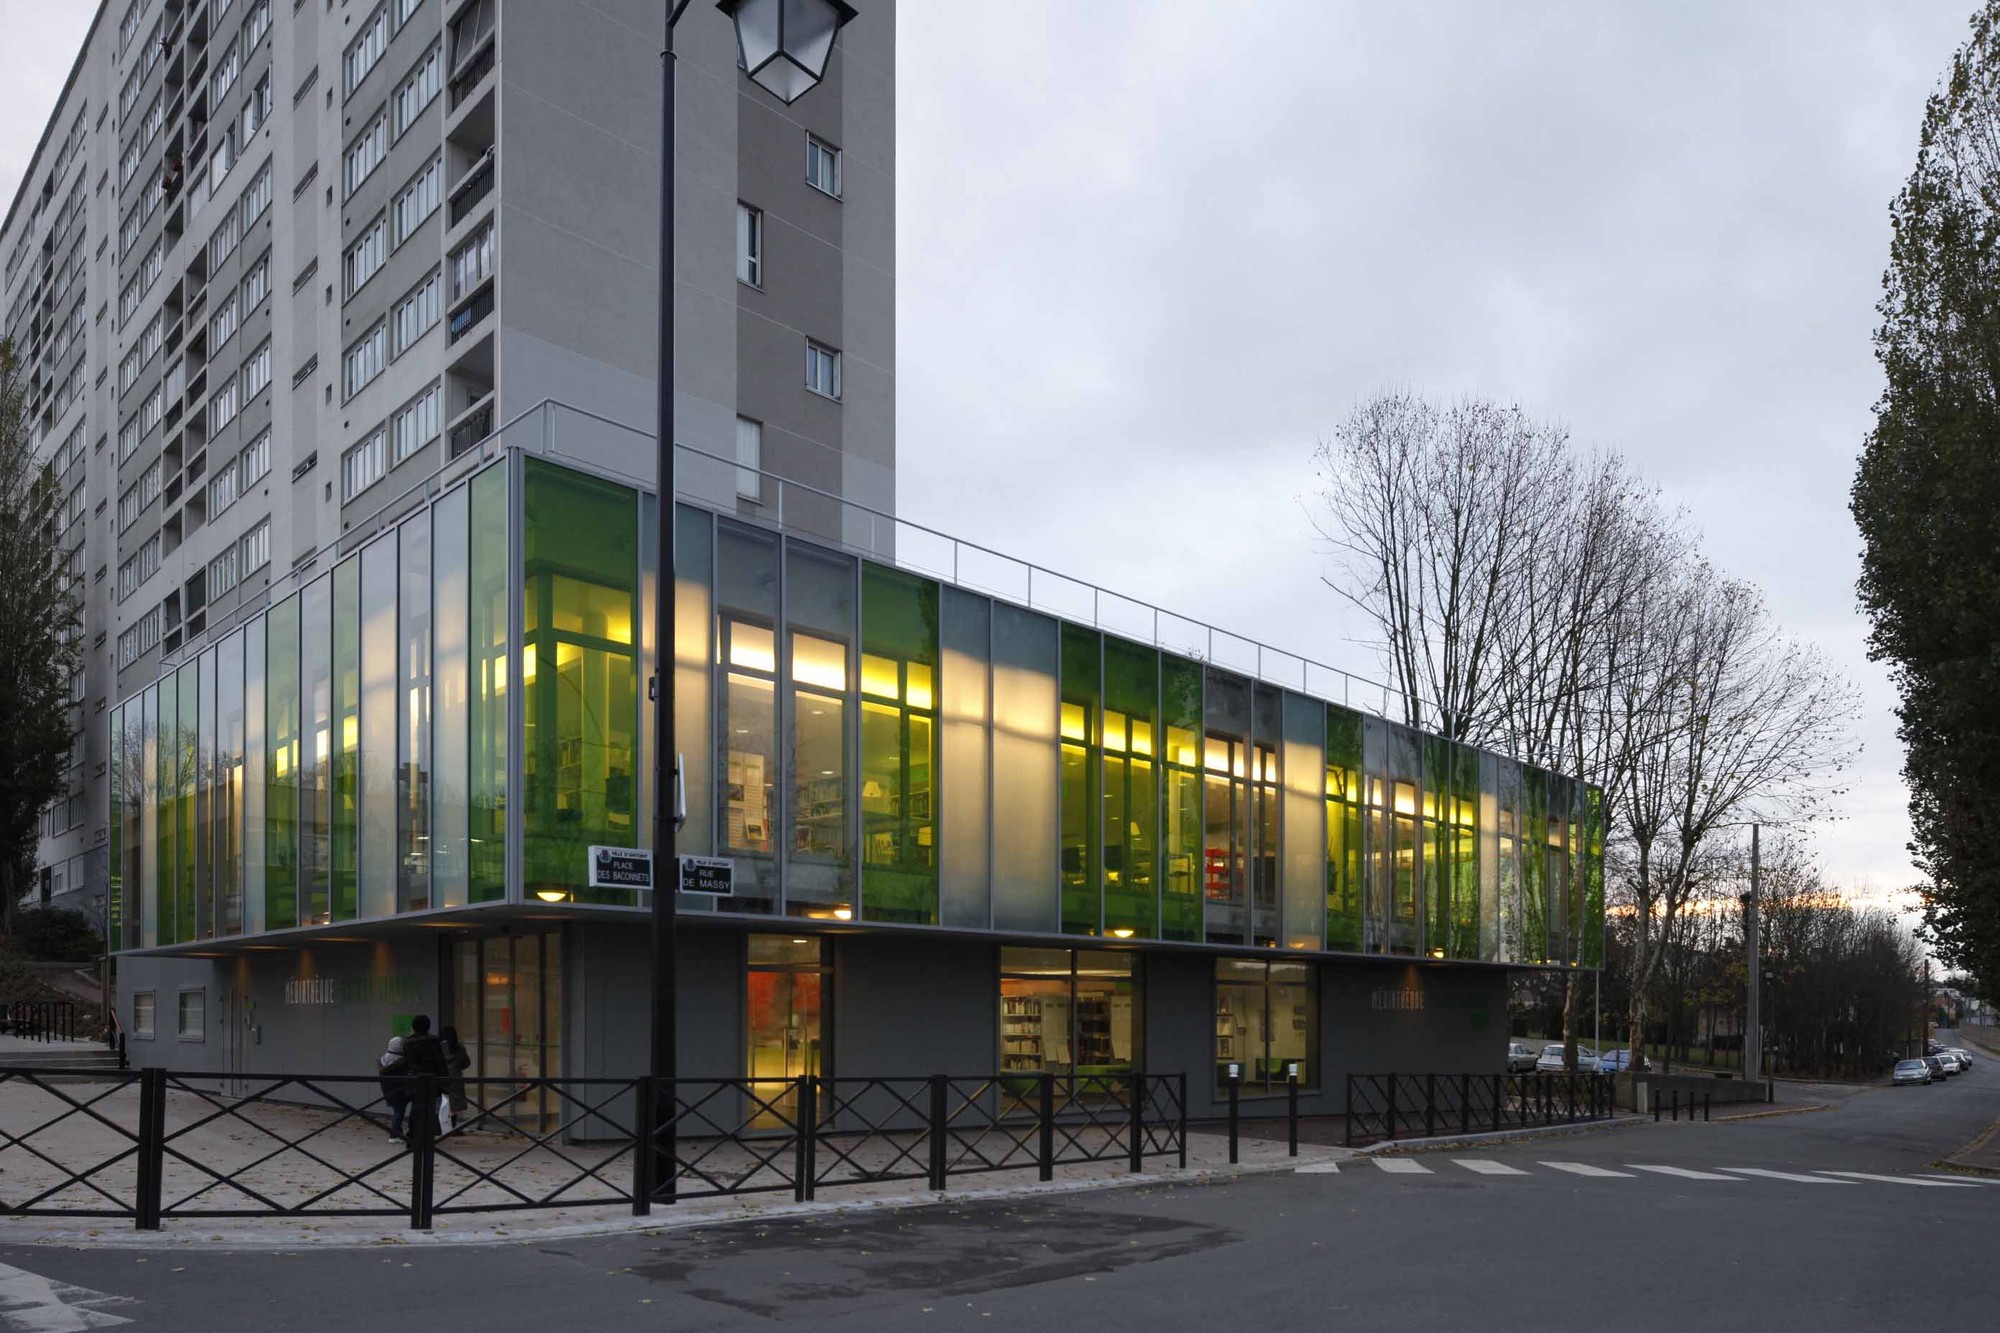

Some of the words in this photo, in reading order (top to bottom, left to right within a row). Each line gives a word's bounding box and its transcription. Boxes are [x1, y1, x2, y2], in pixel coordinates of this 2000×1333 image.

[613, 861, 633, 870] PLACE
[597, 870, 611, 879] DES
[612, 870, 649, 882] BACONNETS
[699, 869, 714, 878] RUE
[683, 878, 695, 887] DE
[699, 879, 730, 889] MASSY
[285, 974, 334, 1005] MÉDIATHÈQUE
